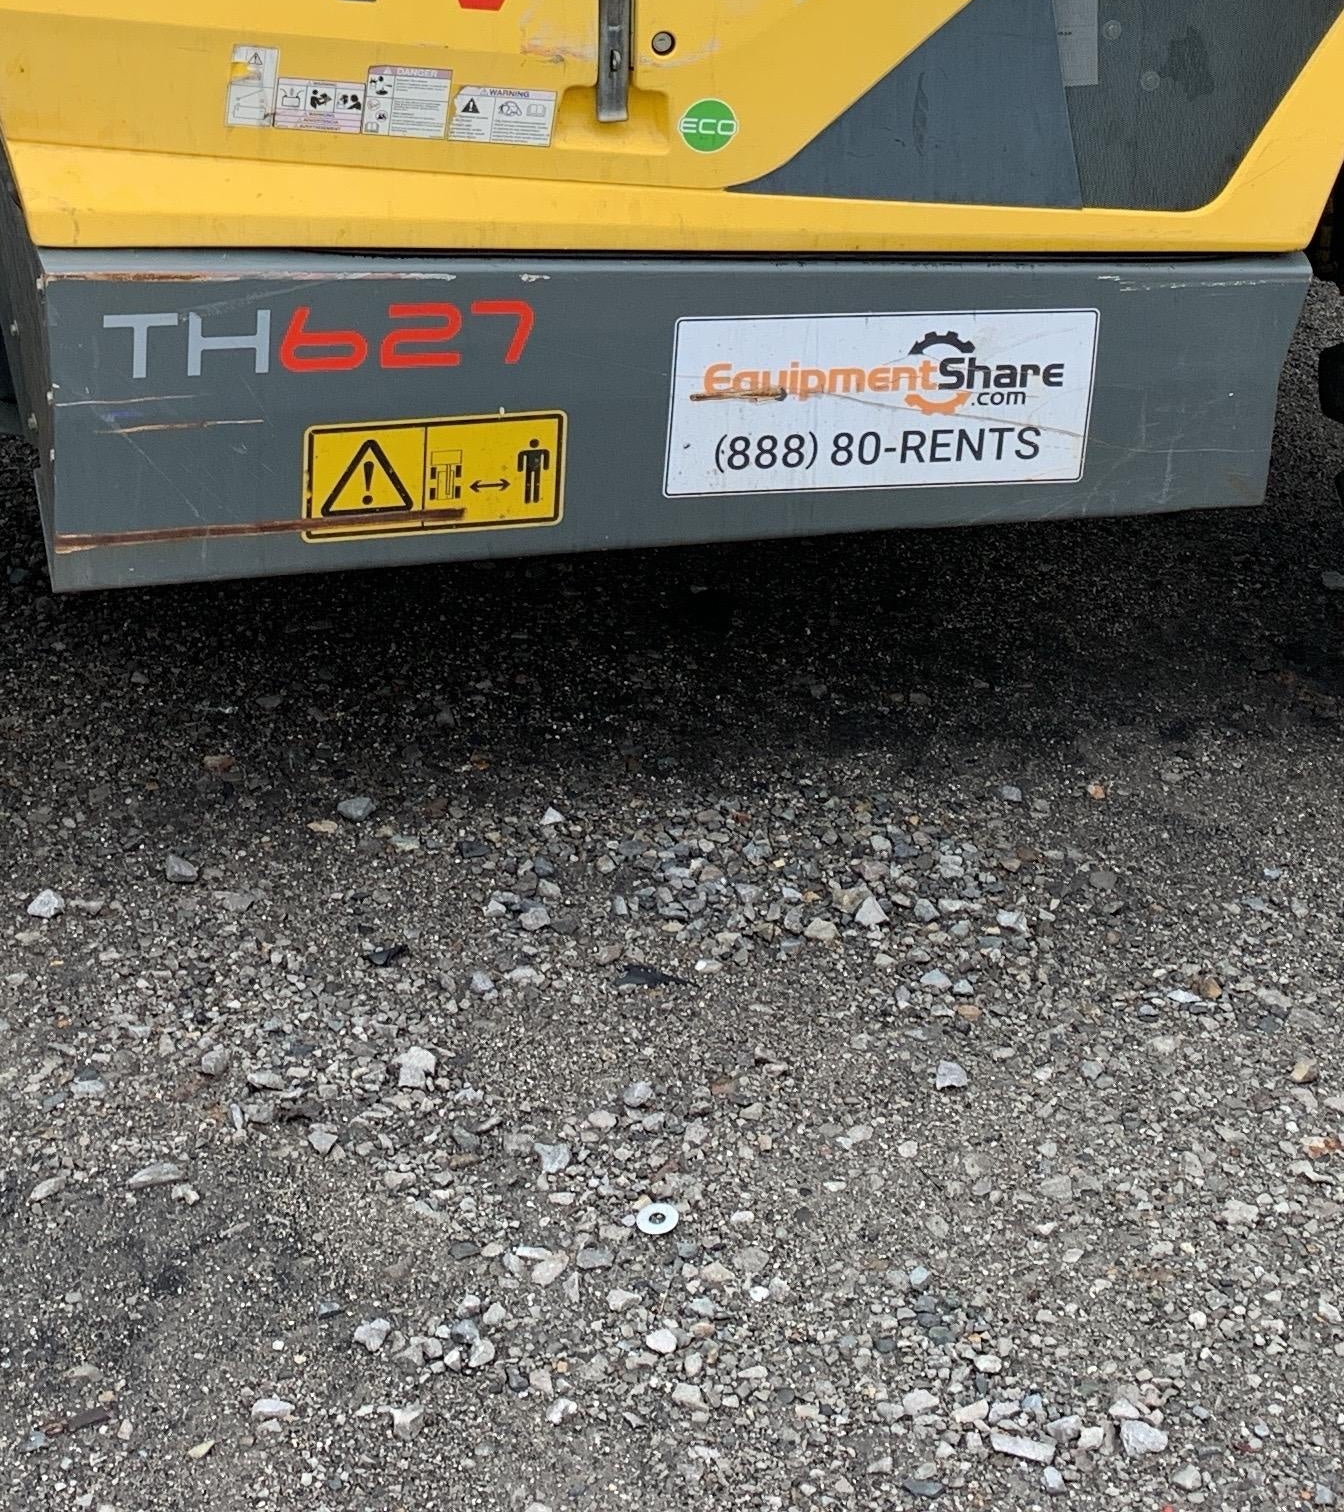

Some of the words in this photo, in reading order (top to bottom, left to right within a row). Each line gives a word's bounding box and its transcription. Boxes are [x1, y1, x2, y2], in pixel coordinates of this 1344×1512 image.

[396, 68, 438, 78] DANGER
[489, 88, 530, 98] WARNING
[679, 117, 737, 136] ECO
[102, 299, 536, 380] TH627
[703, 355, 1065, 403] EquipmentShare
[971, 390, 1027, 407] .com
[714, 431, 819, 473] (888)
[831, 426, 1042, 466] 80-RENTS
